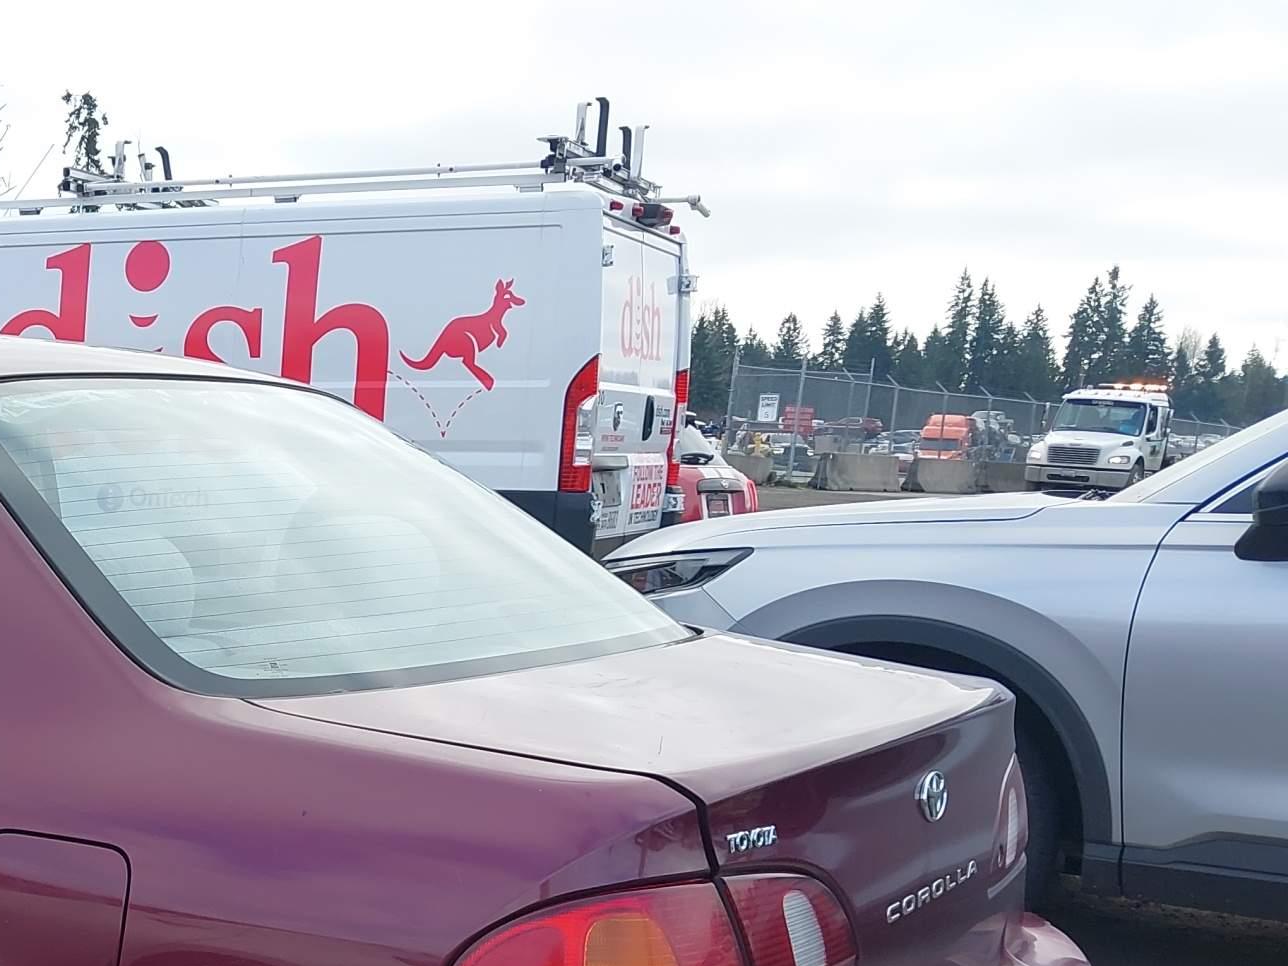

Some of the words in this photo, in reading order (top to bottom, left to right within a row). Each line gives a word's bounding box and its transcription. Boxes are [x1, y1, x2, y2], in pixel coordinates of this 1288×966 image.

[621, 275, 661, 361] dish
[632, 465, 653, 481] FOLLOW
[654, 464, 664, 480] THE
[631, 482, 662, 511] LEADER
[726, 825, 778, 853] TOYOTA
[886, 860, 978, 924] COROLLA
